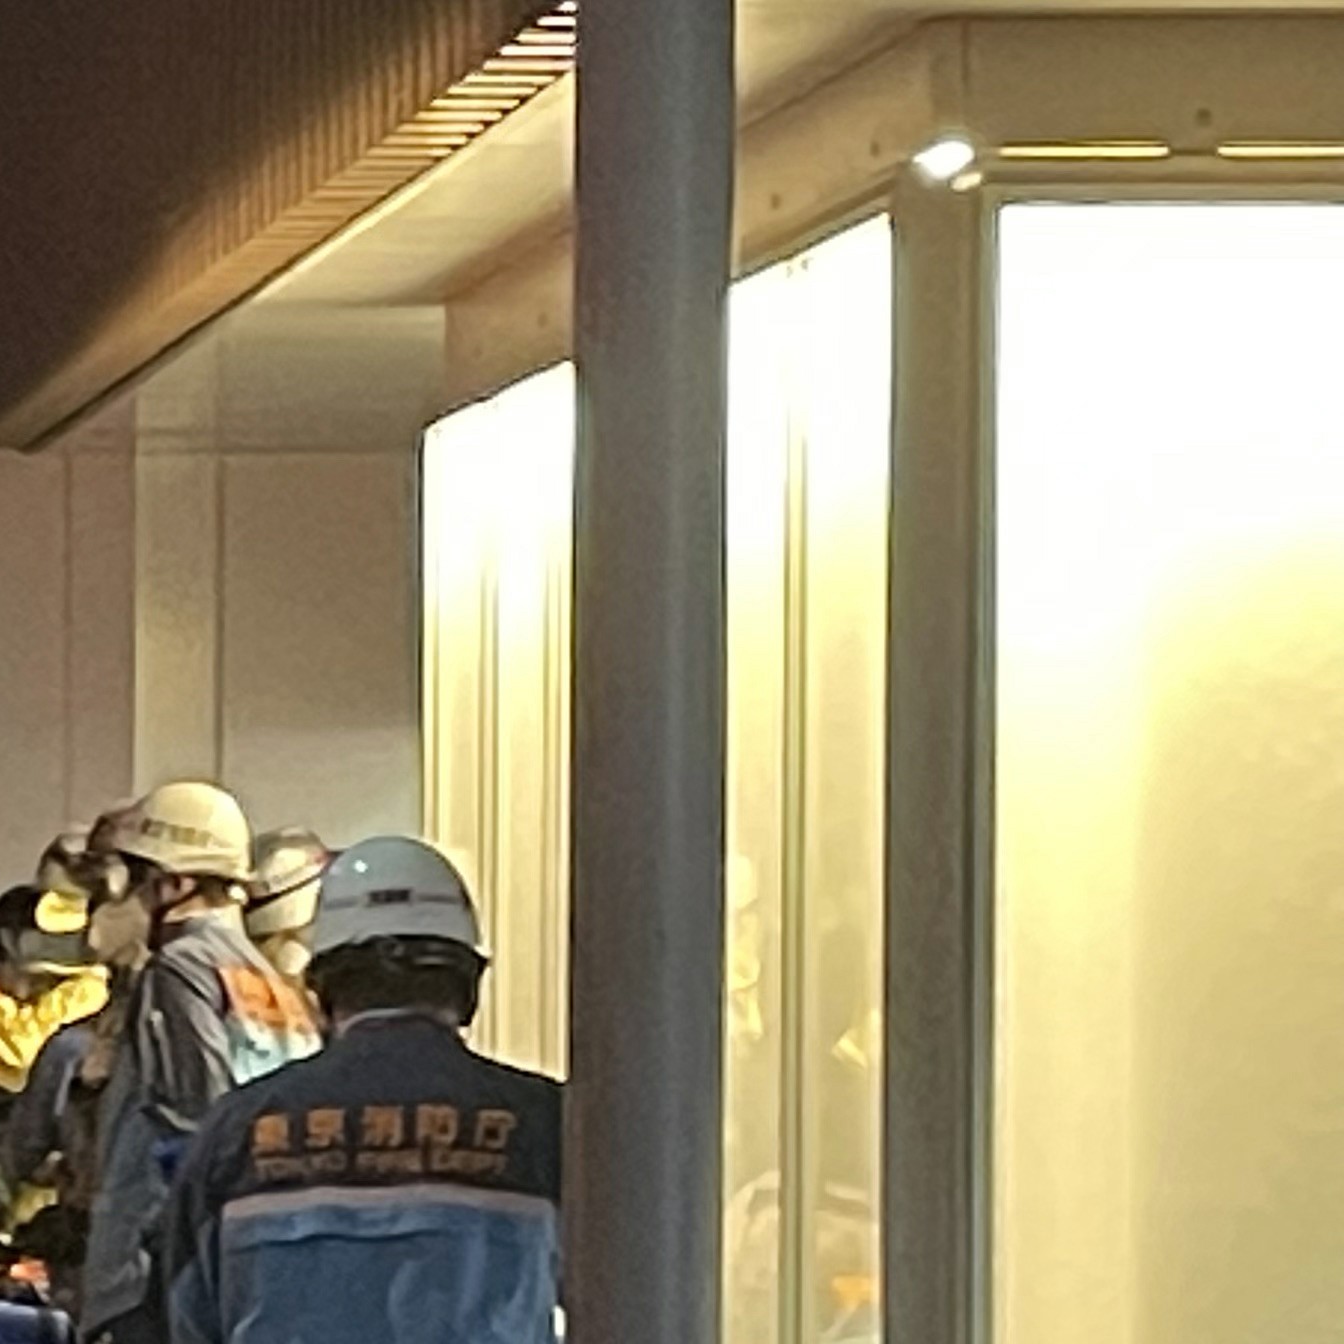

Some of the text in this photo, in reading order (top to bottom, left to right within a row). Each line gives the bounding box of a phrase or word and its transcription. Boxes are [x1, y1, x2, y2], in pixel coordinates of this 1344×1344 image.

[251, 1103, 518, 1155] 東京消防庁
